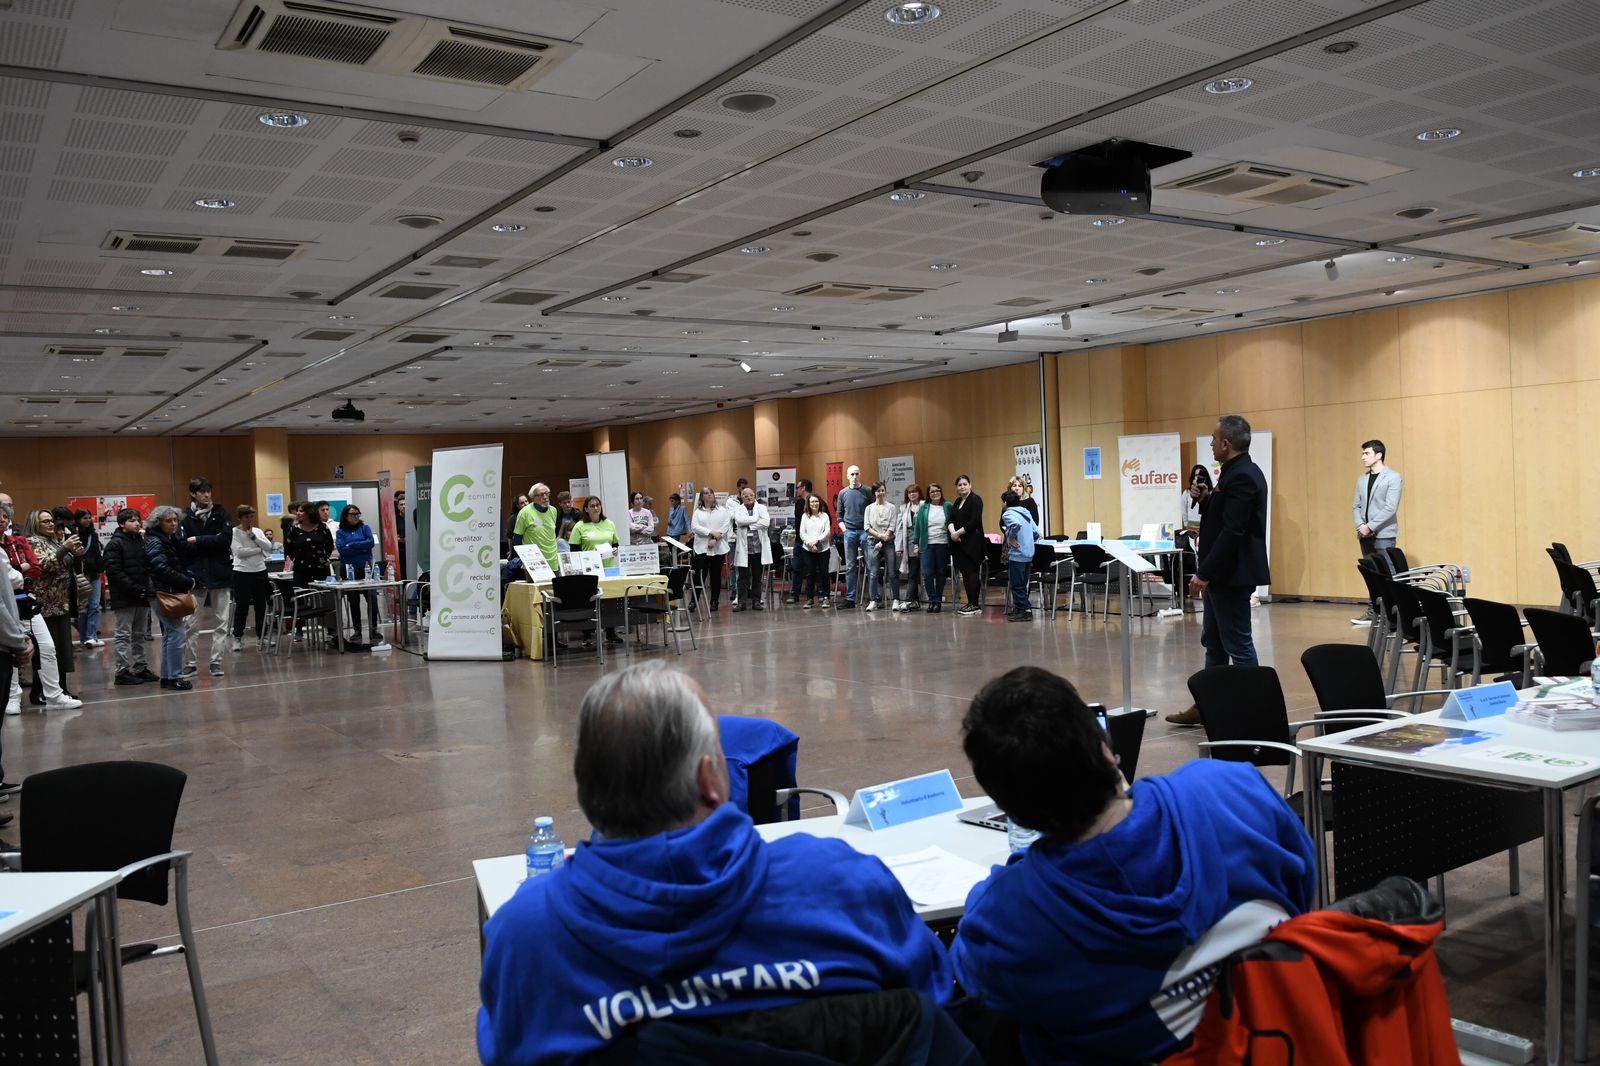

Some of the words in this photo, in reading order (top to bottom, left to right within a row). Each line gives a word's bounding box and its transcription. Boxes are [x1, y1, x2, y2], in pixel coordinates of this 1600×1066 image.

[1131, 470, 1178, 485] aufare
[417, 489, 432, 501] LECT
[477, 521, 495, 529] donar
[454, 535, 483, 544] reutilitzar
[469, 574, 491, 582] reciclar
[581, 959, 819, 1040] VOLUNTARI
